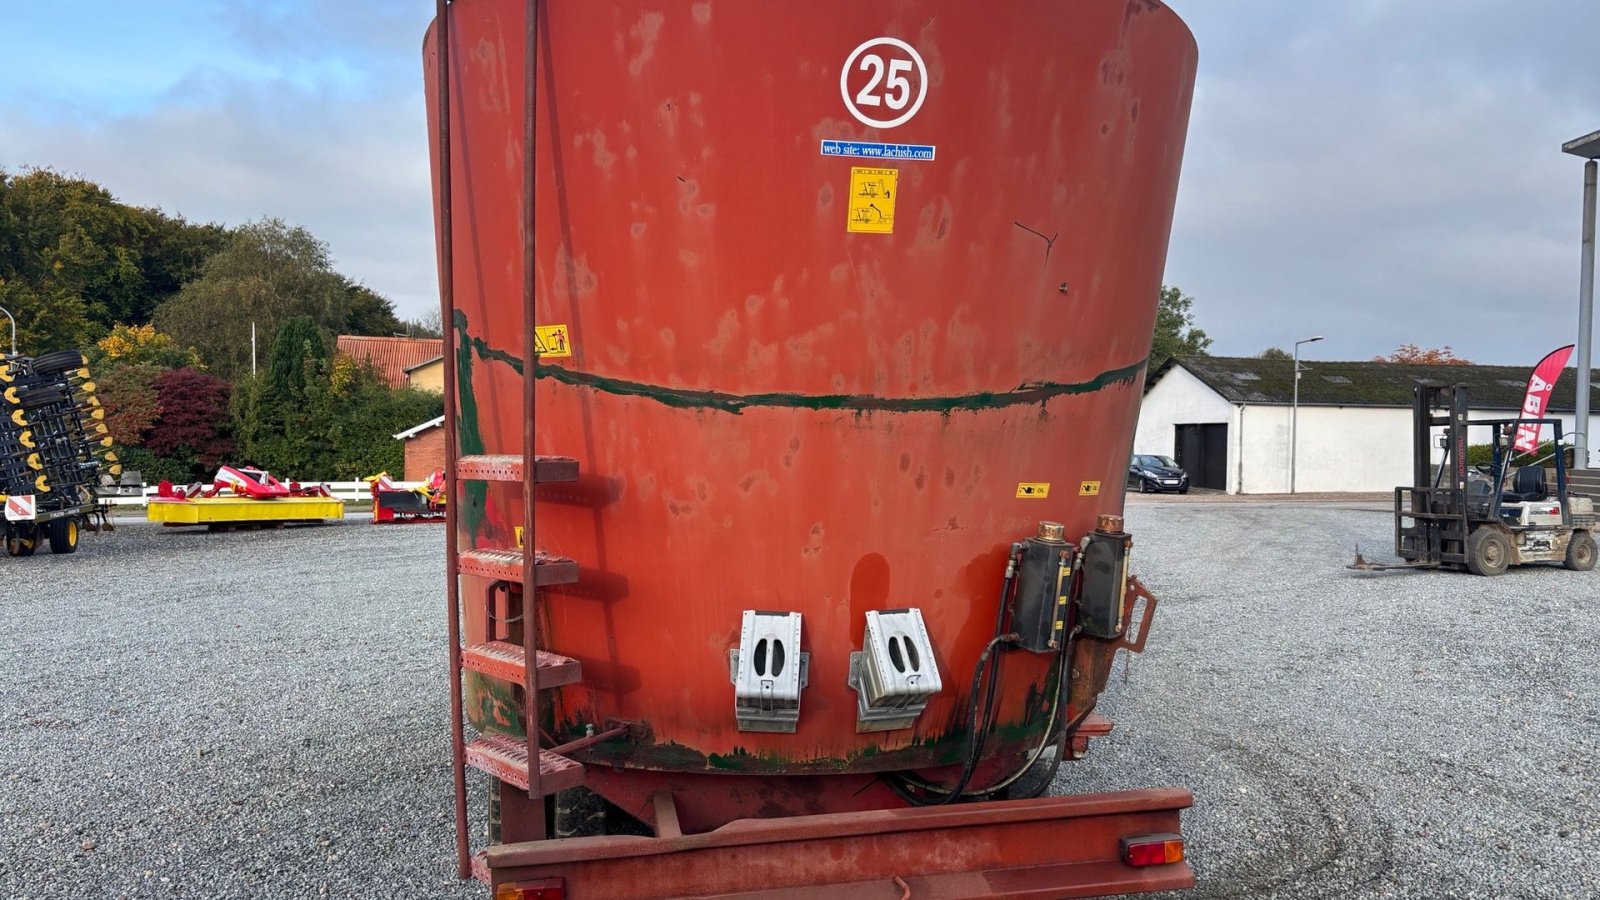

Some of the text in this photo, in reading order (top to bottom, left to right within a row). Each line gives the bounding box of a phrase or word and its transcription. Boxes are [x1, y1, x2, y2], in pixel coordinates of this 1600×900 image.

[856, 54, 913, 109] 25
[823, 142, 932, 158] web site: www.lachish.com
[1514, 374, 1552, 450] ÅBEN
